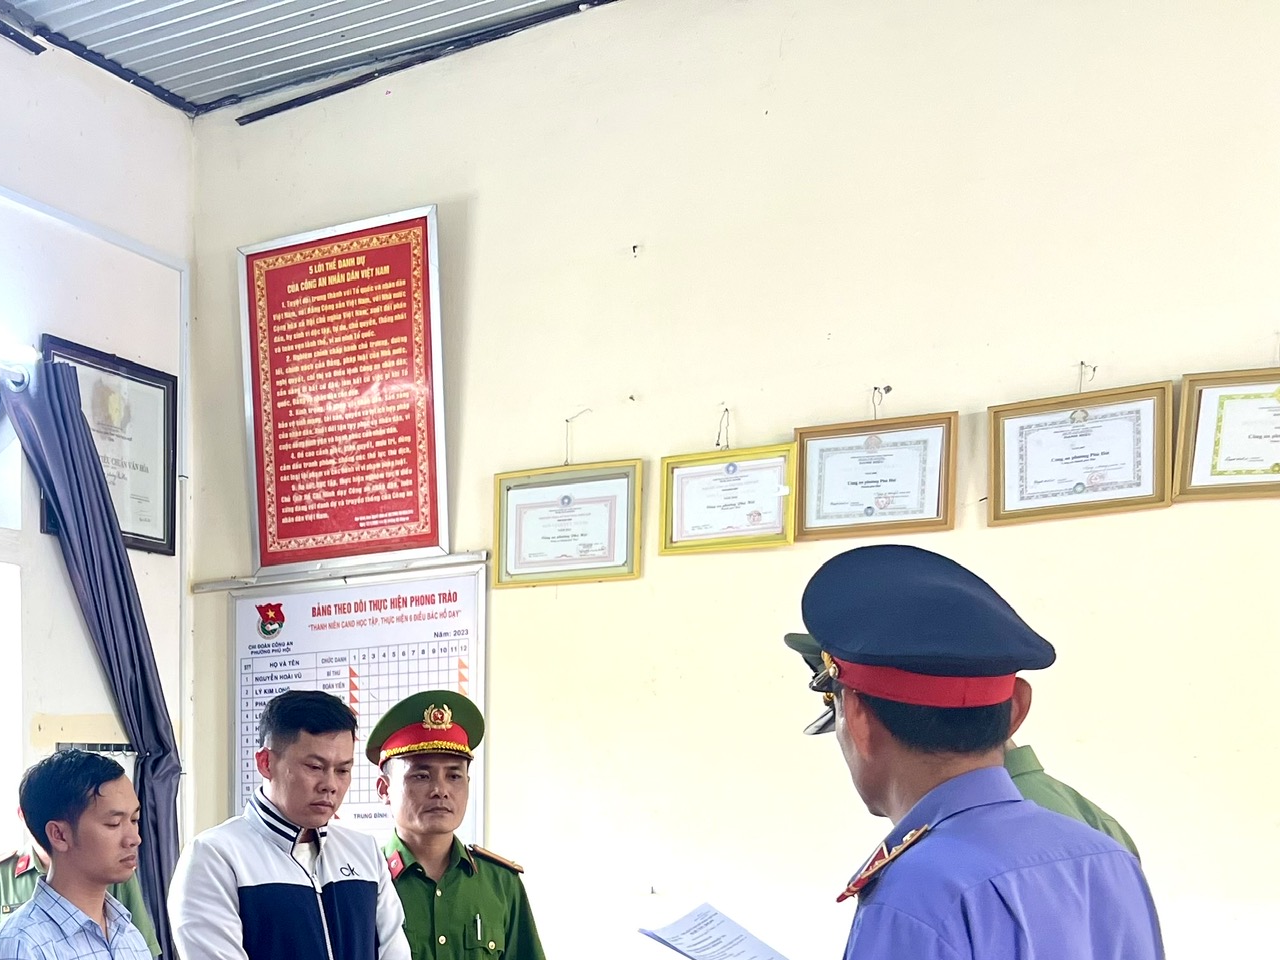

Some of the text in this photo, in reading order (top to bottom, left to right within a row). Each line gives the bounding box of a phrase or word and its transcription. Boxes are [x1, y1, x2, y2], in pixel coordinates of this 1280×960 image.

[309, 266, 314, 275] 5
[337, 257, 356, 269] DANH
[287, 265, 390, 294] CỦA CÔNG AN NHÂN DÂN VIỆT NAM
[311, 590, 458, 618] BẢNG THEO DÕI THỰC HIỆN PHONG TRÀO
[453, 629, 469, 637] 2023
[279, 659, 287, 667] VÀ
[255, 673, 279, 682] NGUYỄN
[279, 672, 293, 680] HOÀI
